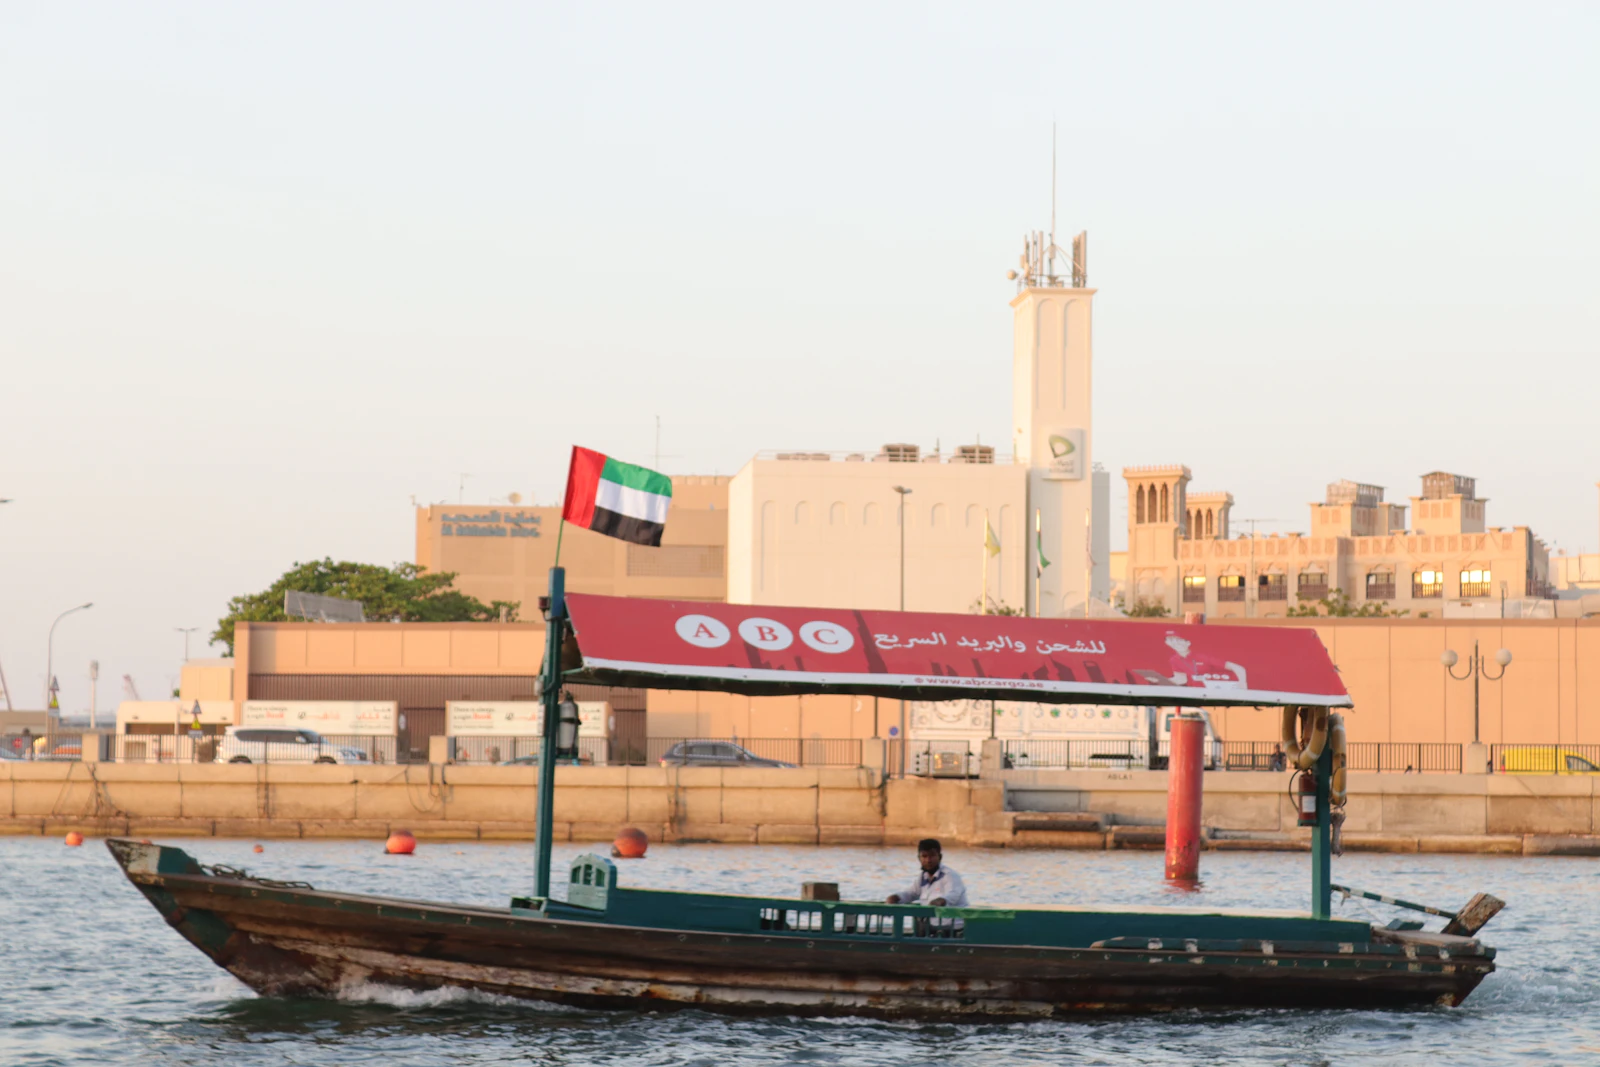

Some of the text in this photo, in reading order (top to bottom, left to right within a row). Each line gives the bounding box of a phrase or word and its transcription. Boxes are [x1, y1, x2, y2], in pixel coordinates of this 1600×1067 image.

[693, 622, 839, 645] A B C
[873, 631, 1107, 655] للشحن والبريد السريع
[926, 677, 1045, 689] www.abccargo.ae
